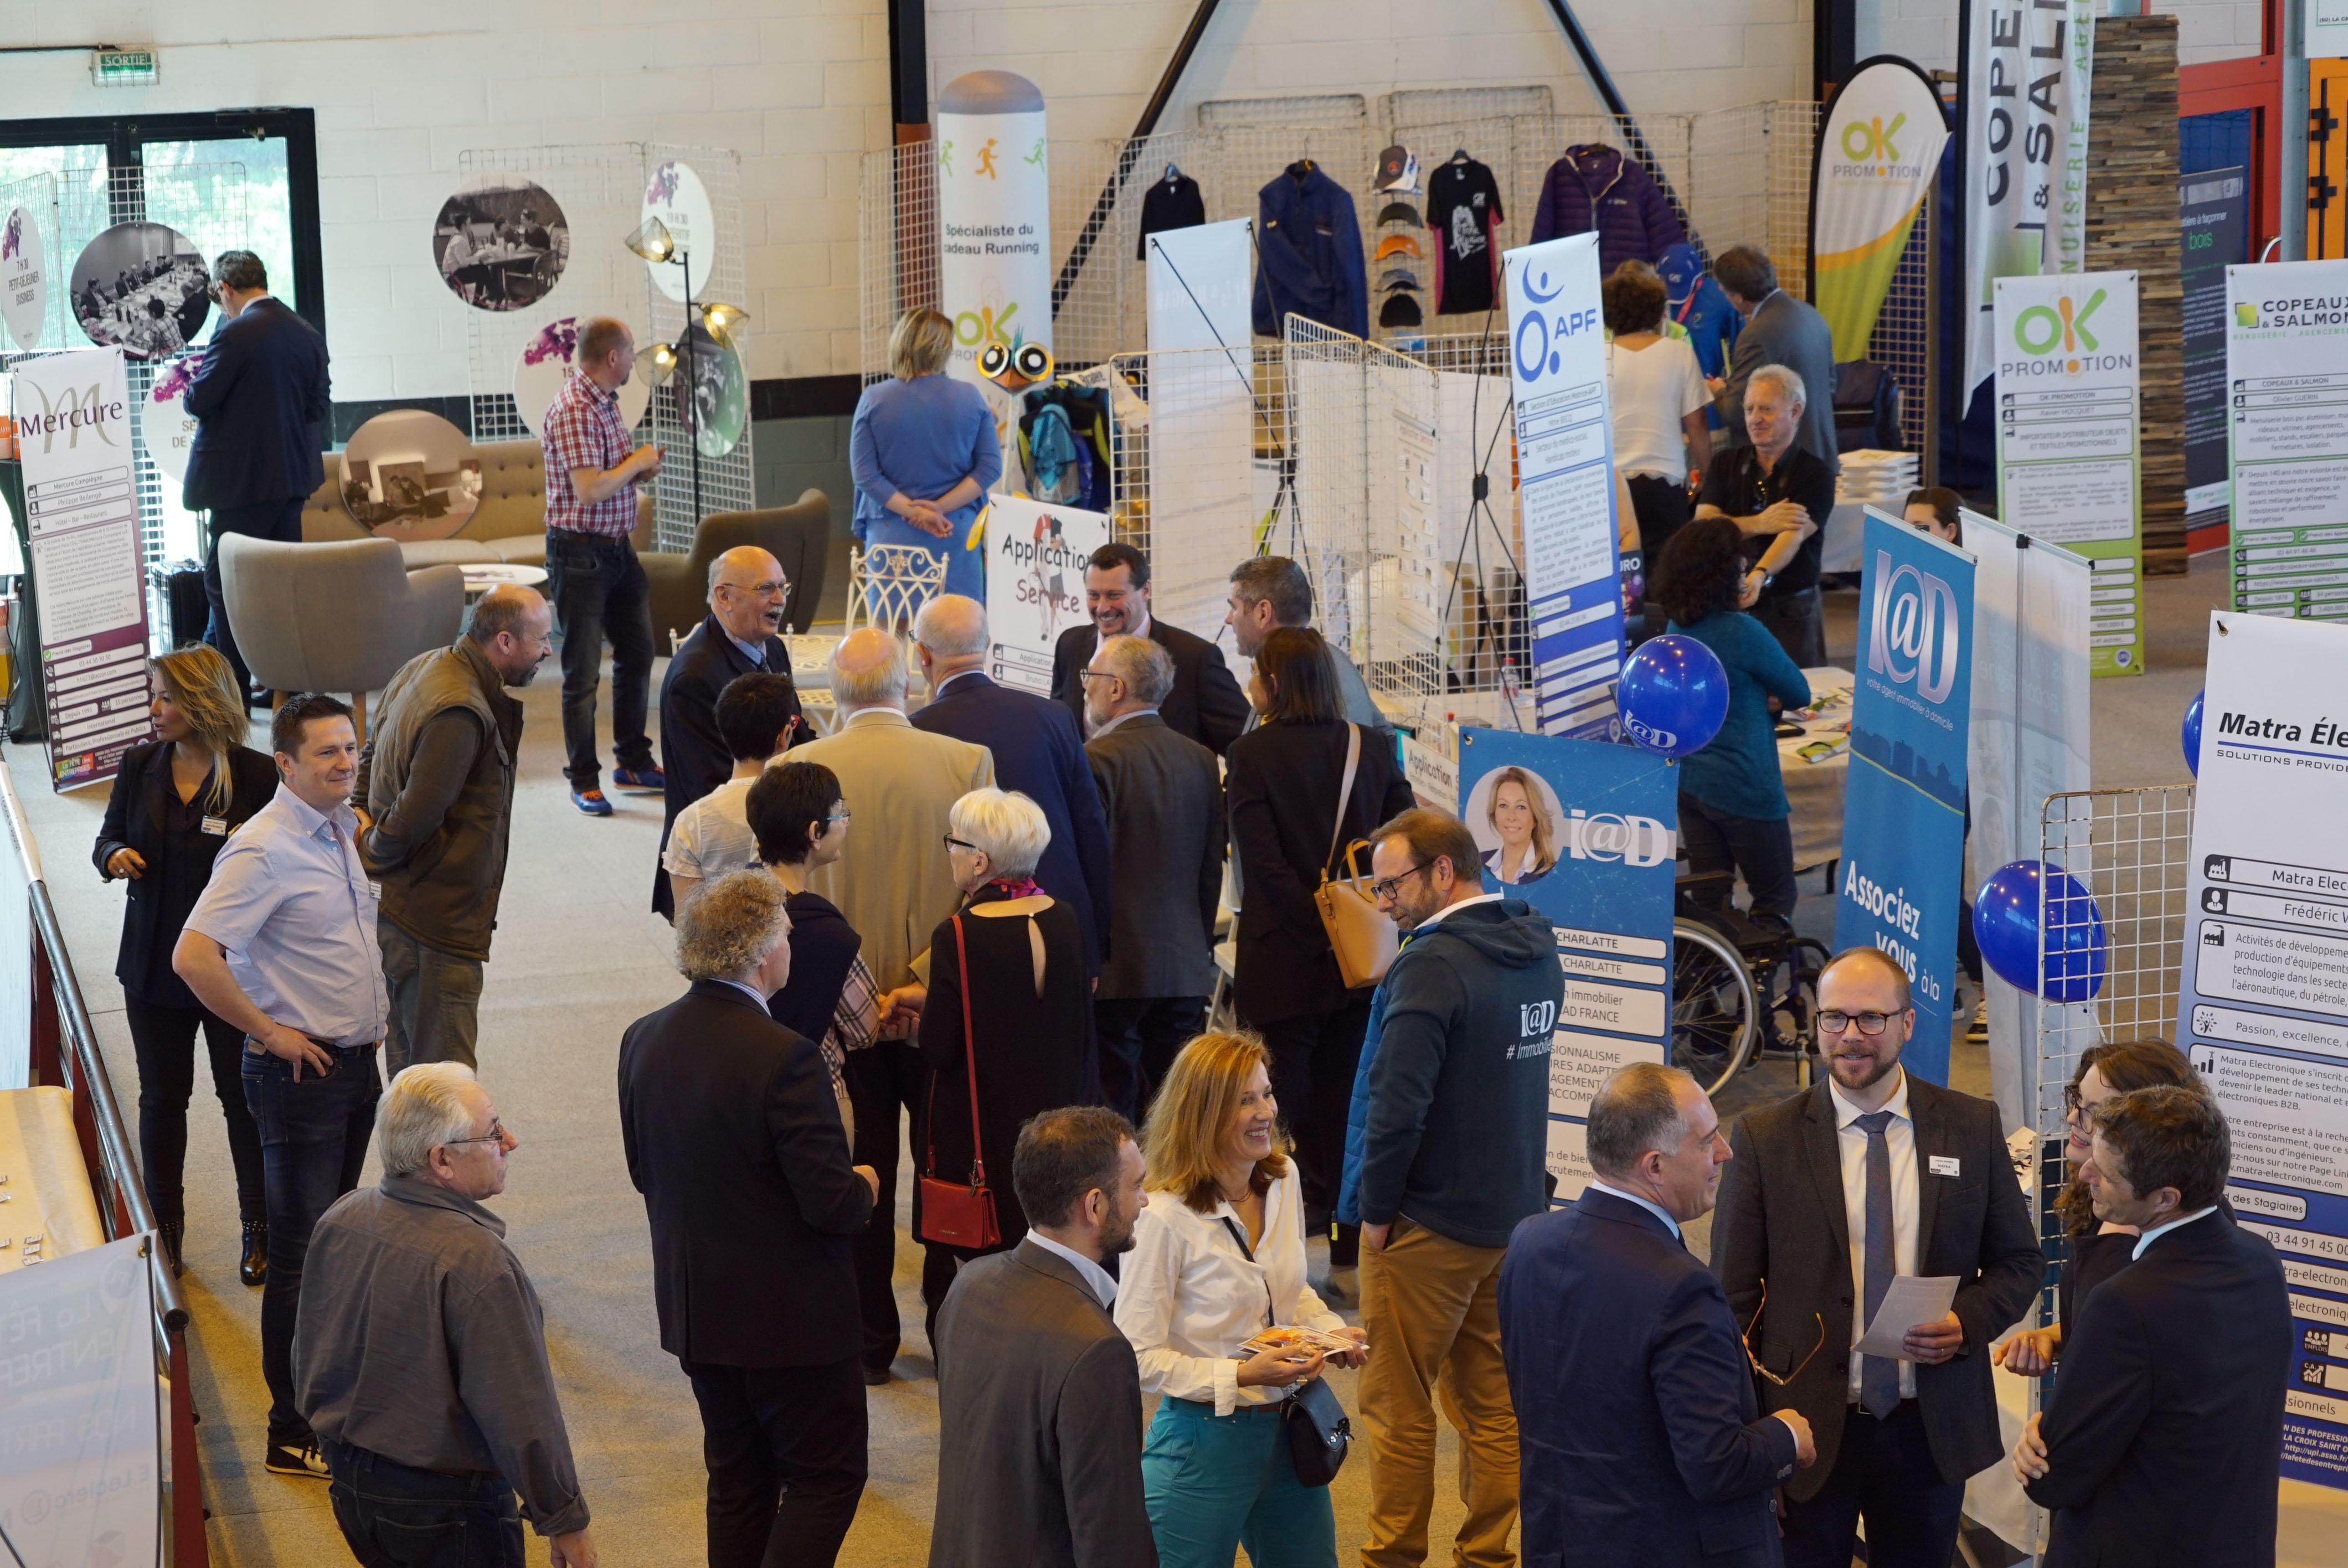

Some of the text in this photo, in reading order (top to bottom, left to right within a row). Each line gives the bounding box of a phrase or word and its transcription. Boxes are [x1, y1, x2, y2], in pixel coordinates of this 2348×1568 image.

[106, 55, 146, 66] SORTIE
[1987, 0, 2022, 207] COPE
[1841, 112, 1906, 162] OK
[2035, 184, 2051, 210] &
[2060, 121, 2087, 273] NUISERIE
[946, 224, 1034, 238] Spécialiste du
[2189, 229, 2213, 250] bois
[986, 243, 1039, 256] Running
[8, 270, 39, 291] PETIT-DÉJEUNER
[16, 288, 34, 306] BUSINESS
[955, 302, 1018, 347] OK
[1554, 308, 1596, 339] APF
[2014, 288, 2107, 356] OK
[2300, 377, 2329, 385] SALMON
[2051, 392, 2095, 400] PROMOTION
[20, 402, 122, 438] Mercure
[54, 479, 74, 489] Mercure
[58, 497, 78, 506] Philippe
[84, 510, 107, 520] Restaurant
[1016, 579, 1080, 613] Service
[121, 694, 144, 705] personnes
[1866, 677, 1954, 731] votre agent immobilier à domicile
[65, 710, 81, 719] Depuis
[87, 718, 115, 729] International
[2218, 712, 2301, 742] Matra
[2217, 750, 2290, 765] SOLUTIONS
[1409, 750, 1452, 788] Application
[2272, 870, 2348, 891] Matra Elec
[1845, 860, 1920, 941] Associez
[2284, 904, 2339, 923] Frédéric
[1556, 932, 1619, 949] CHARLATTE
[2236, 933, 2287, 949] Activités de
[1563, 958, 1622, 974] CHARLATTE
[2234, 950, 2282, 964] production
[1921, 968, 1939, 1002] à la
[2233, 964, 2322, 986] technologie dans les
[1572, 988, 1623, 1006] immobilier
[2232, 979, 2347, 1008] l'aéronautique, du pétrole,
[1579, 1008, 1620, 1023] FRANCE
[2236, 1022, 2342, 1048] Passion, excellence,
[1550, 1044, 1621, 1064] SIONNALISME
[2220, 1067, 2320, 1090] développement de ses
[2221, 1055, 2342, 1082] Matra Electronique s'inscrit
[2217, 1090, 2301, 1111] électroniques B2B.
[2218, 1079, 2344, 1106] devenir le leader national et
[2243, 1118, 2323, 1138] entreprise est à la
[2247, 1132, 2342, 1154] constamment, que ce
[1557, 1151, 1568, 1160] de
[2231, 1152, 2331, 1176] ez-nous sur notre Page
[2265, 1146, 2336, 1164] ou d'ingénieurs.
[2233, 1194, 2303, 1213] des Stagiaires
[2267, 1231, 2280, 1243] 03
[2284, 1235, 2298, 1246] 44
[2301, 1237, 2314, 1249] 91
[2319, 1241, 2333, 1252] 45
[2304, 1343, 2328, 1353] EMPLOIS
[2291, 1426, 2305, 1435] DES
[2294, 1436, 2316, 1447] CROIX
[2319, 1441, 2339, 1453] SAINT
